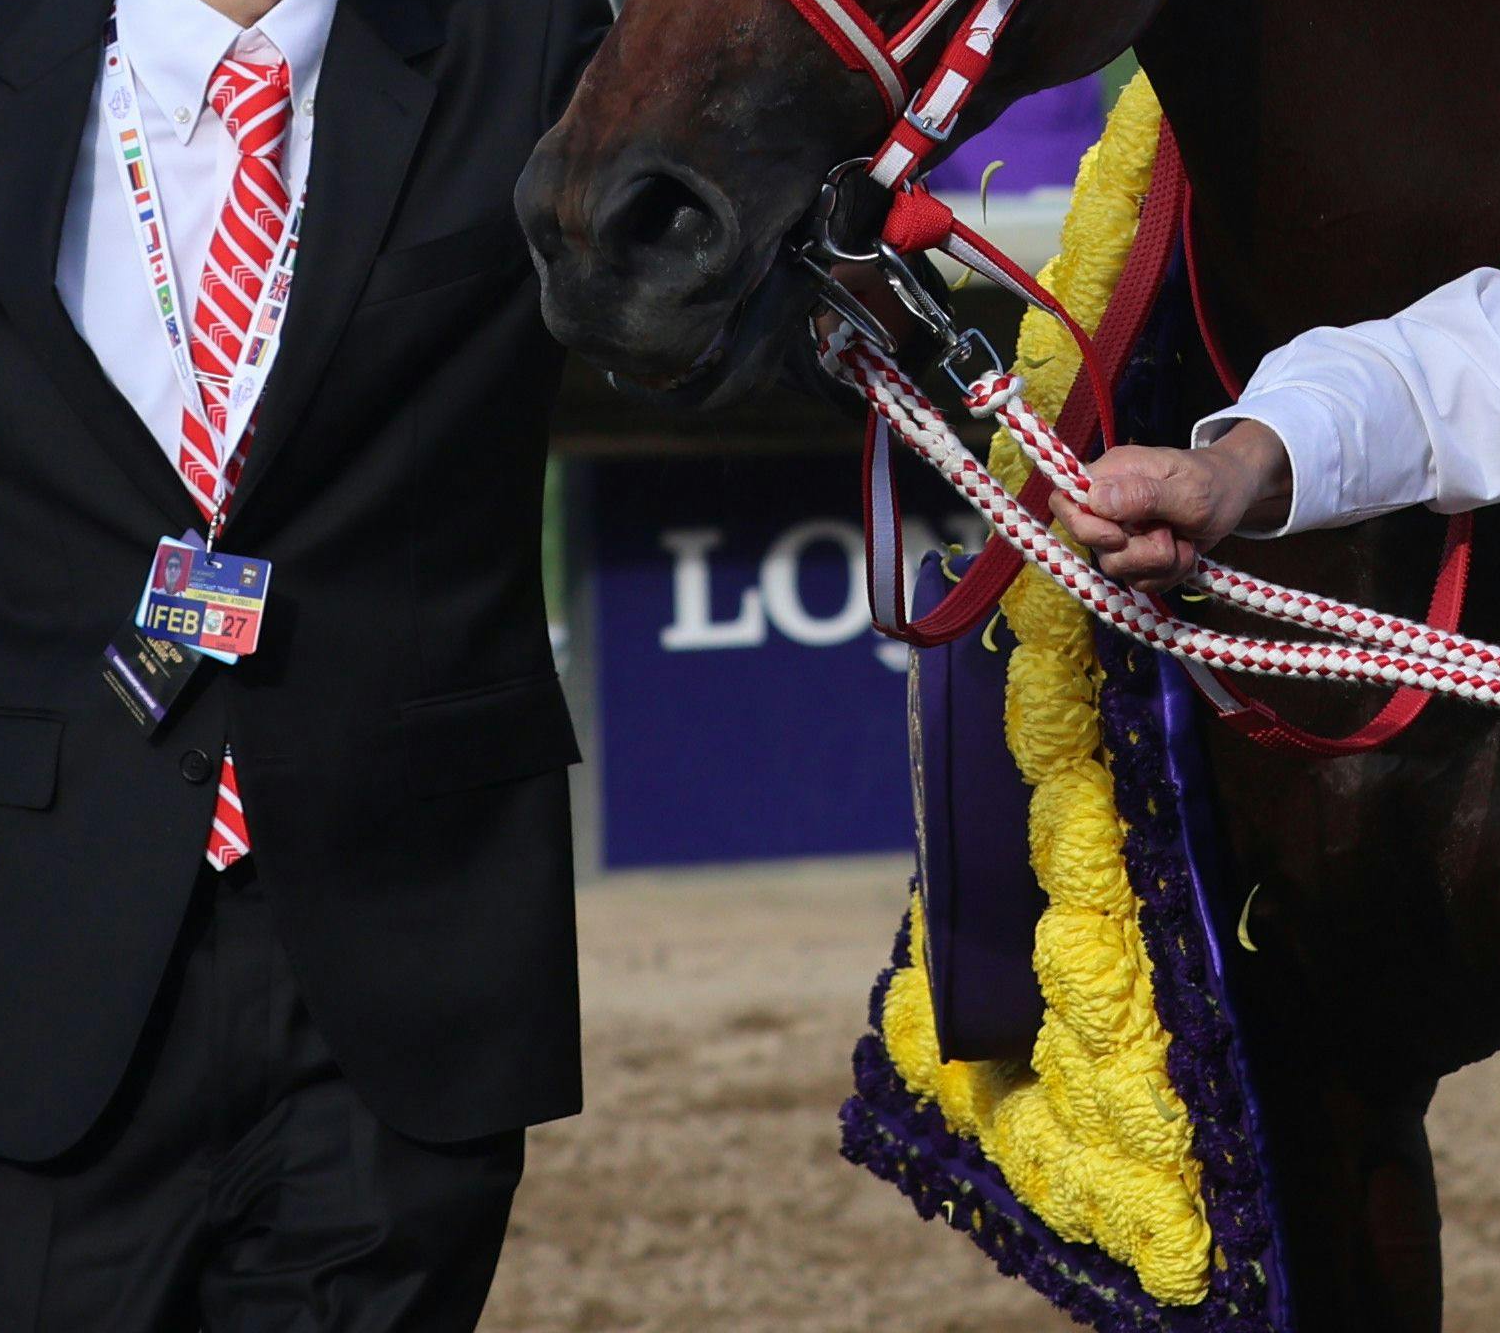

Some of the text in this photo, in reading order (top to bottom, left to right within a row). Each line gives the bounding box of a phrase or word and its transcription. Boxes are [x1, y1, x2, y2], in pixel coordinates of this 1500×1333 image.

[660, 520, 980, 652] LO
[153, 605, 199, 635] FEB
[222, 616, 248, 638] 27
